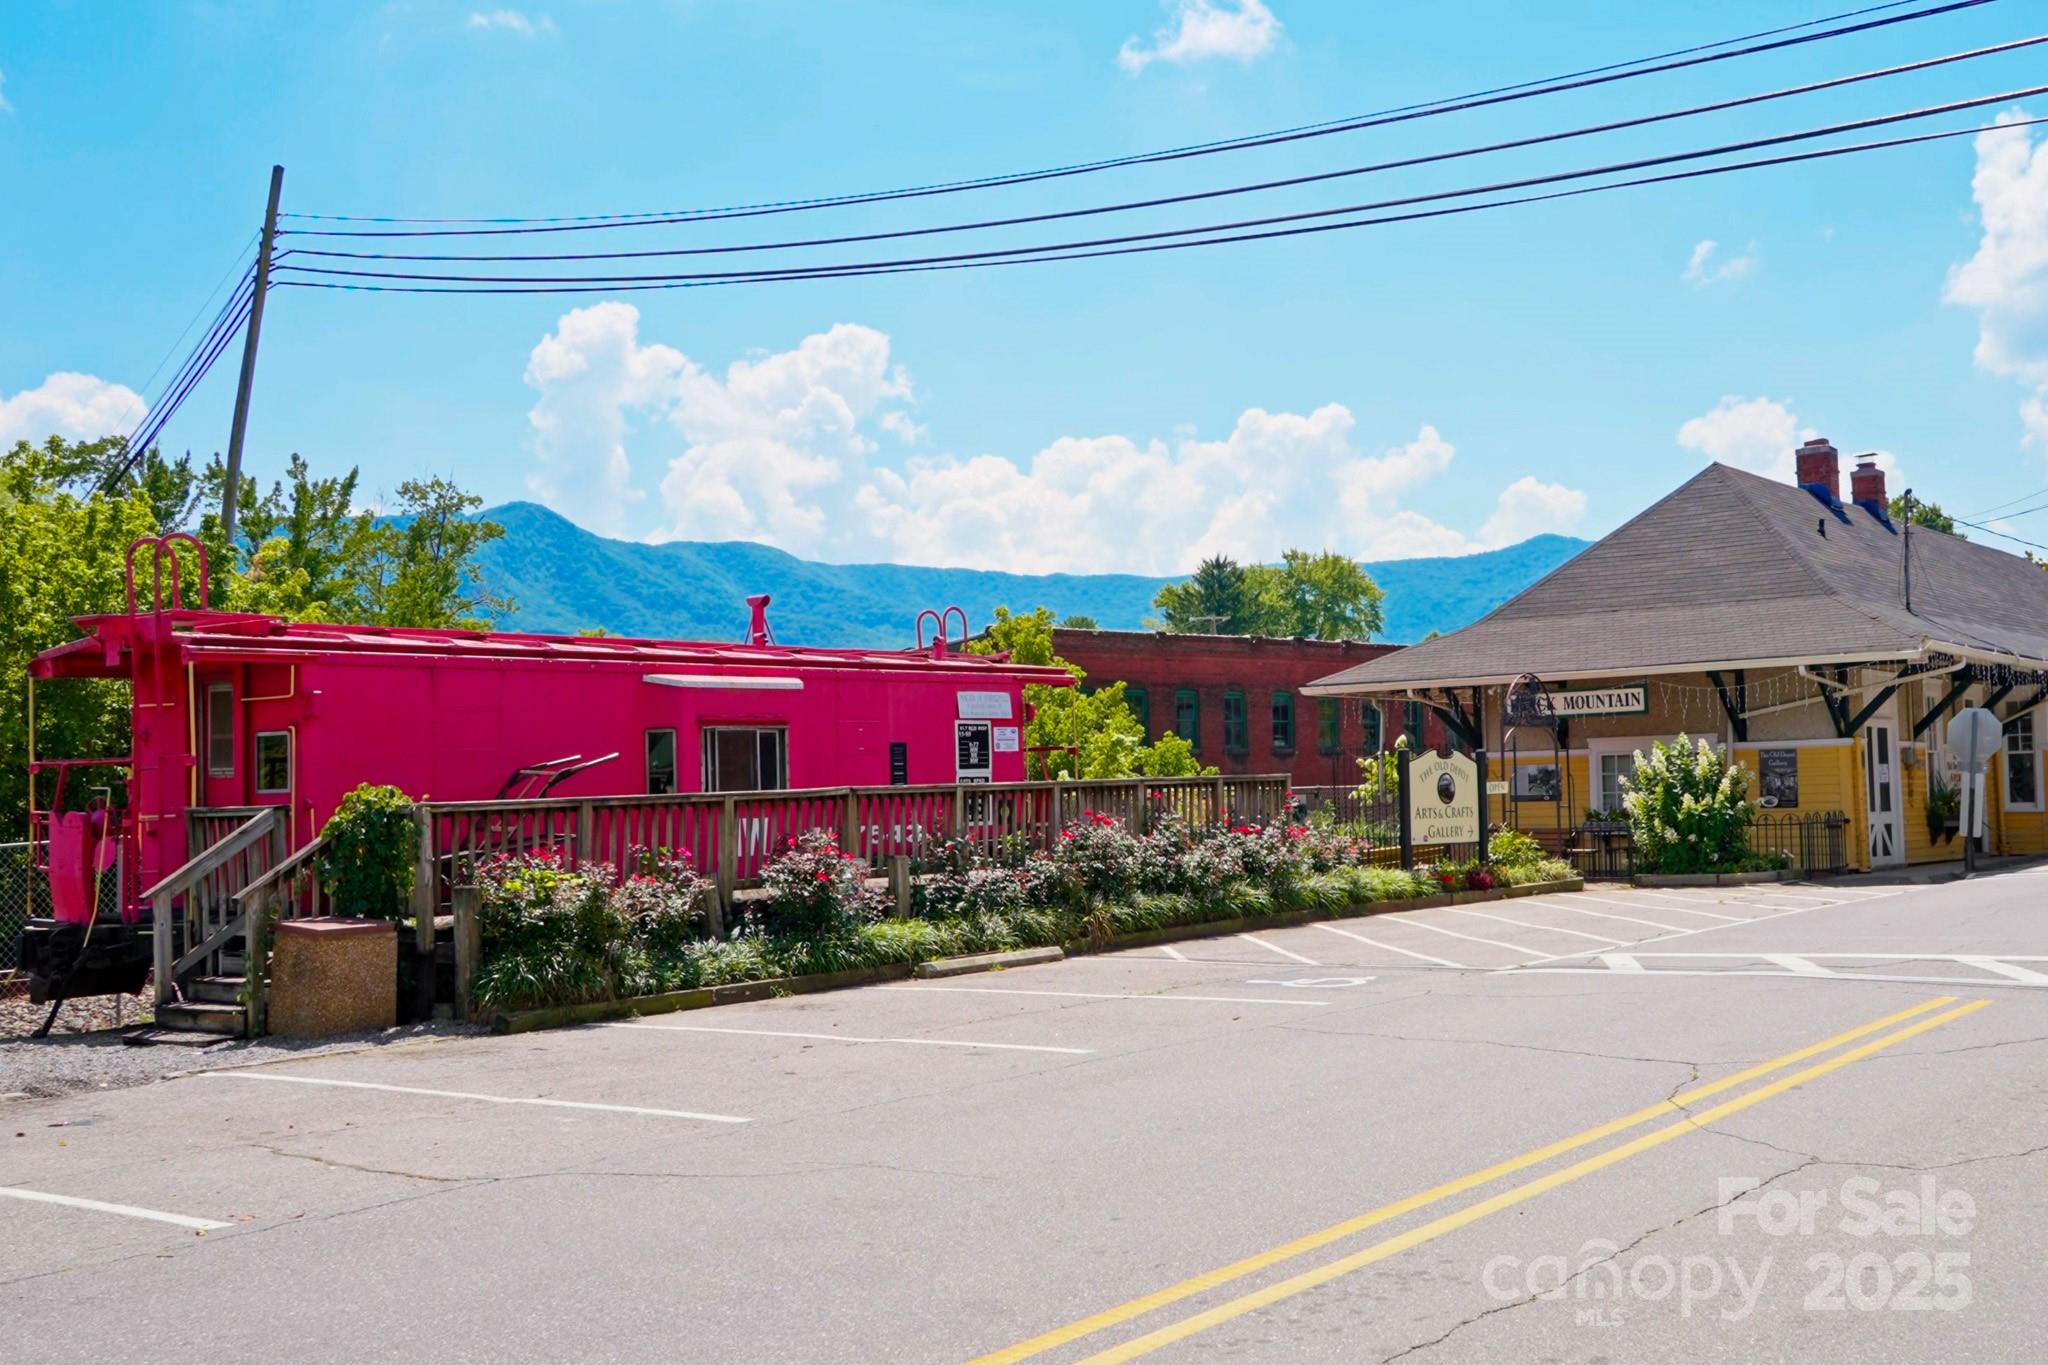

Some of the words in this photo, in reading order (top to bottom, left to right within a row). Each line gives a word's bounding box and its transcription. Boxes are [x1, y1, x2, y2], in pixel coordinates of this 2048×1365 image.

[1563, 691, 1642, 711] MOUNTAIN
[1419, 766, 1434, 783] THE
[1434, 761, 1449, 772] OLD
[1450, 763, 1470, 782] DEPOT
[1489, 783, 1505, 793] OPEN
[1415, 806, 1437, 819] ARTS
[1444, 805, 1474, 819] CRAFTS
[1428, 824, 1464, 839] GALLERY
